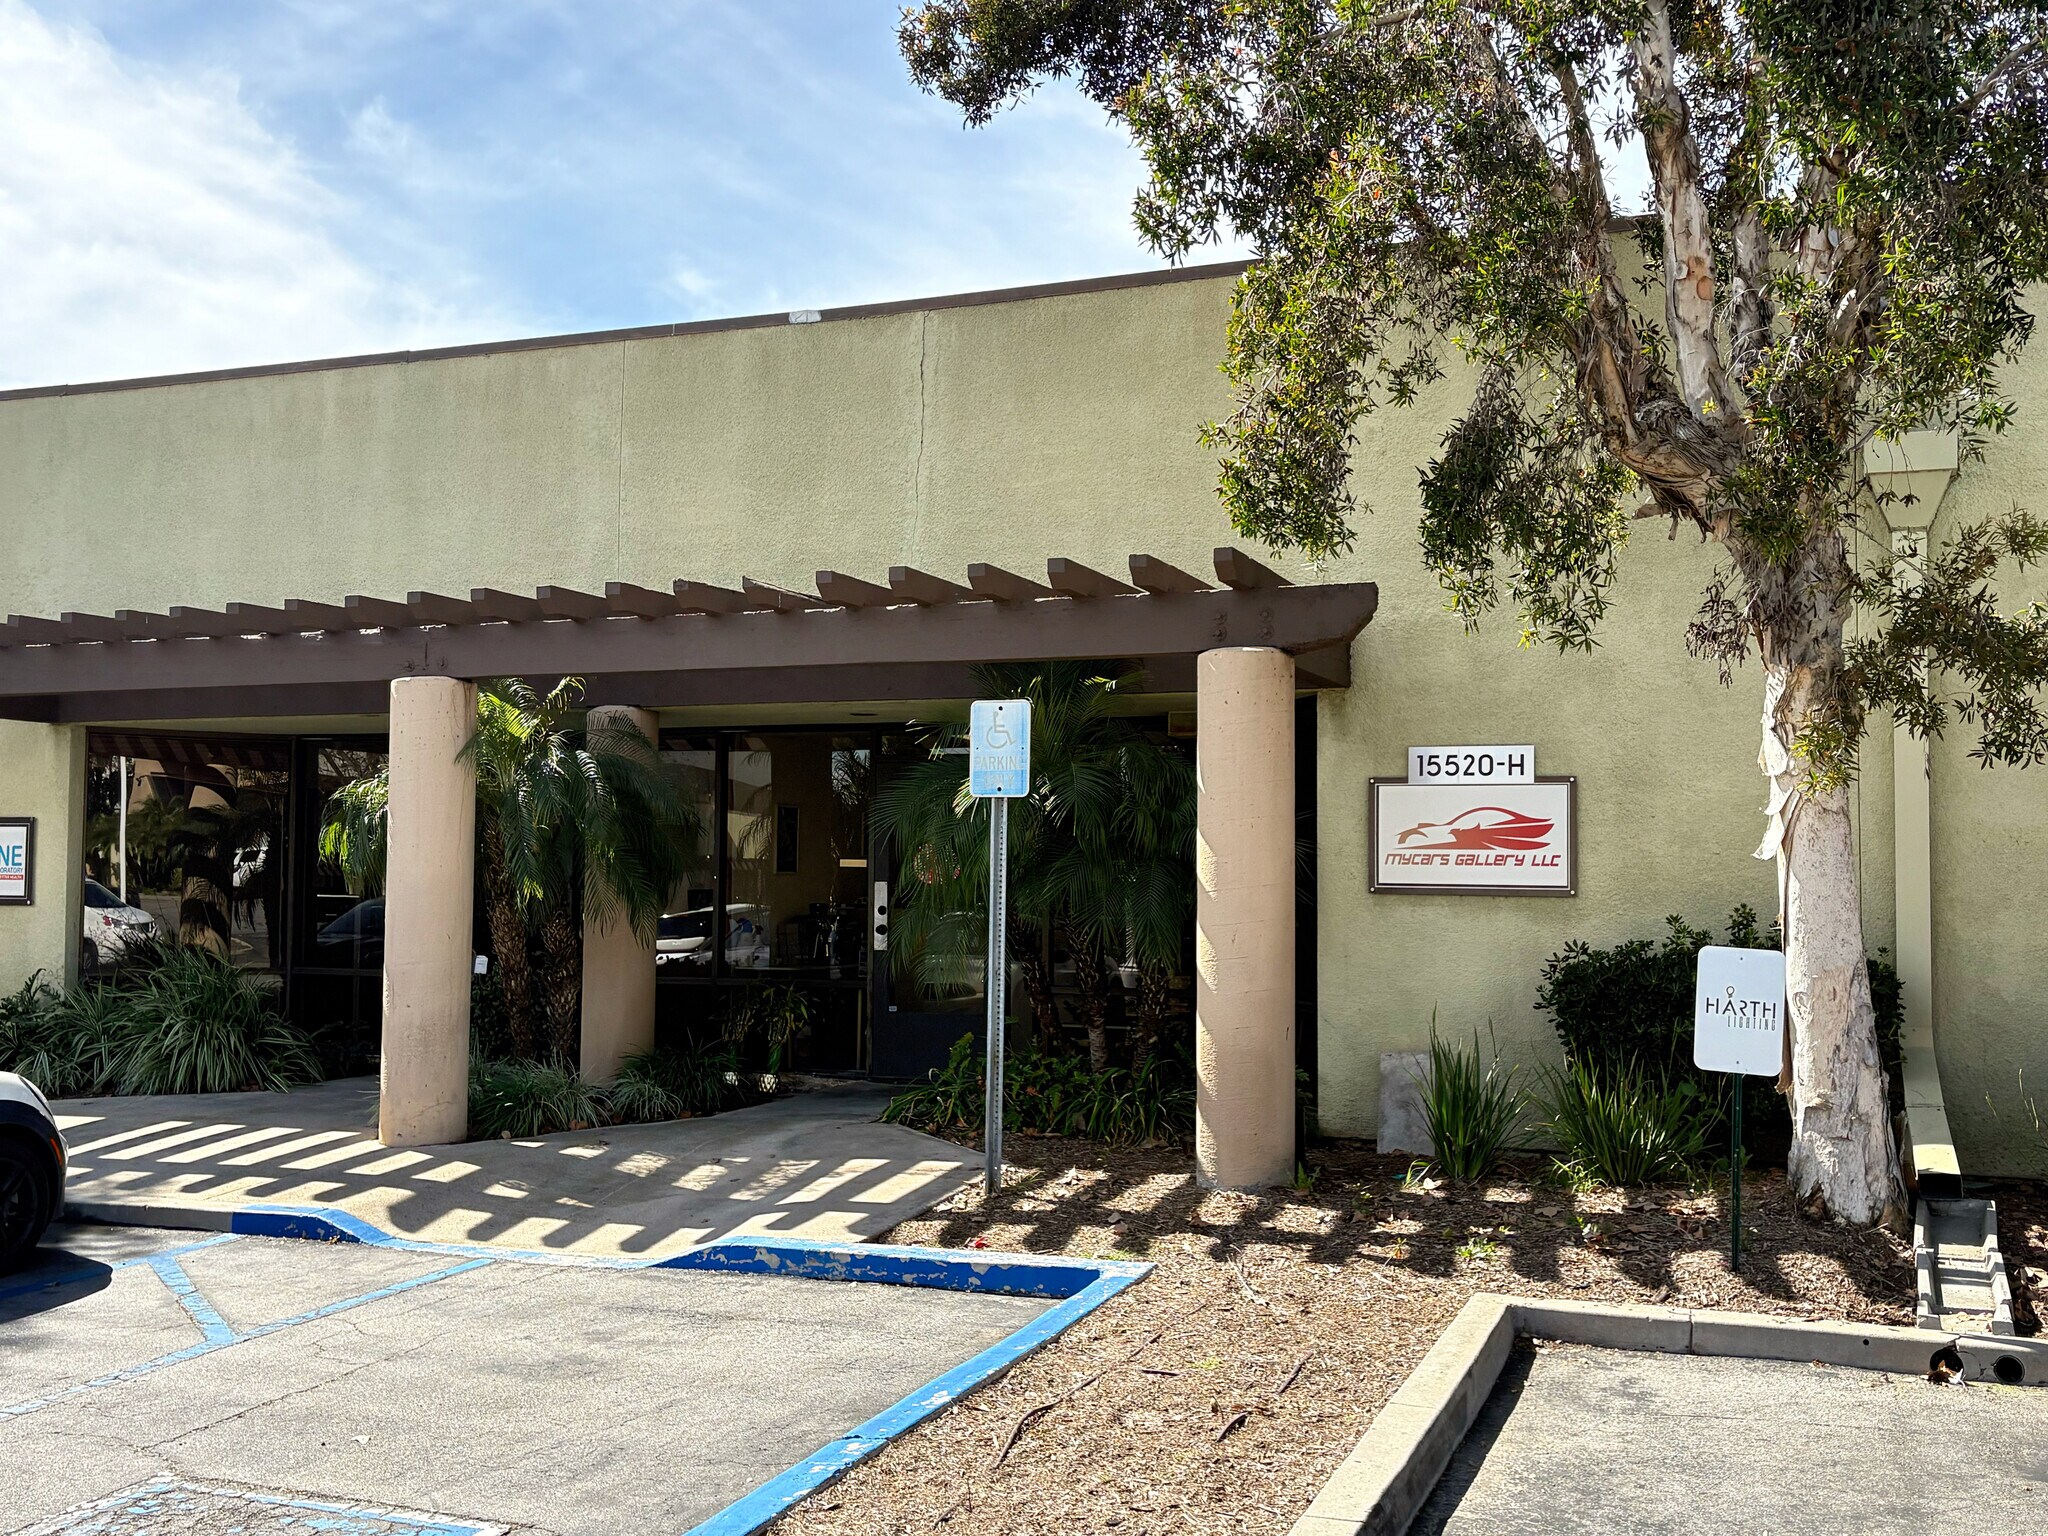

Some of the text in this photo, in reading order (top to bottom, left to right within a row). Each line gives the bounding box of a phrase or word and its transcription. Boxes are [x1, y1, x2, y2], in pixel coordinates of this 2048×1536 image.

[1416, 754, 1525, 776] 15520-H
[1531, 855, 1562, 867] LLC
[1705, 997, 1777, 1019] HARTH
[1727, 1015, 1776, 1031] LIGHTING
